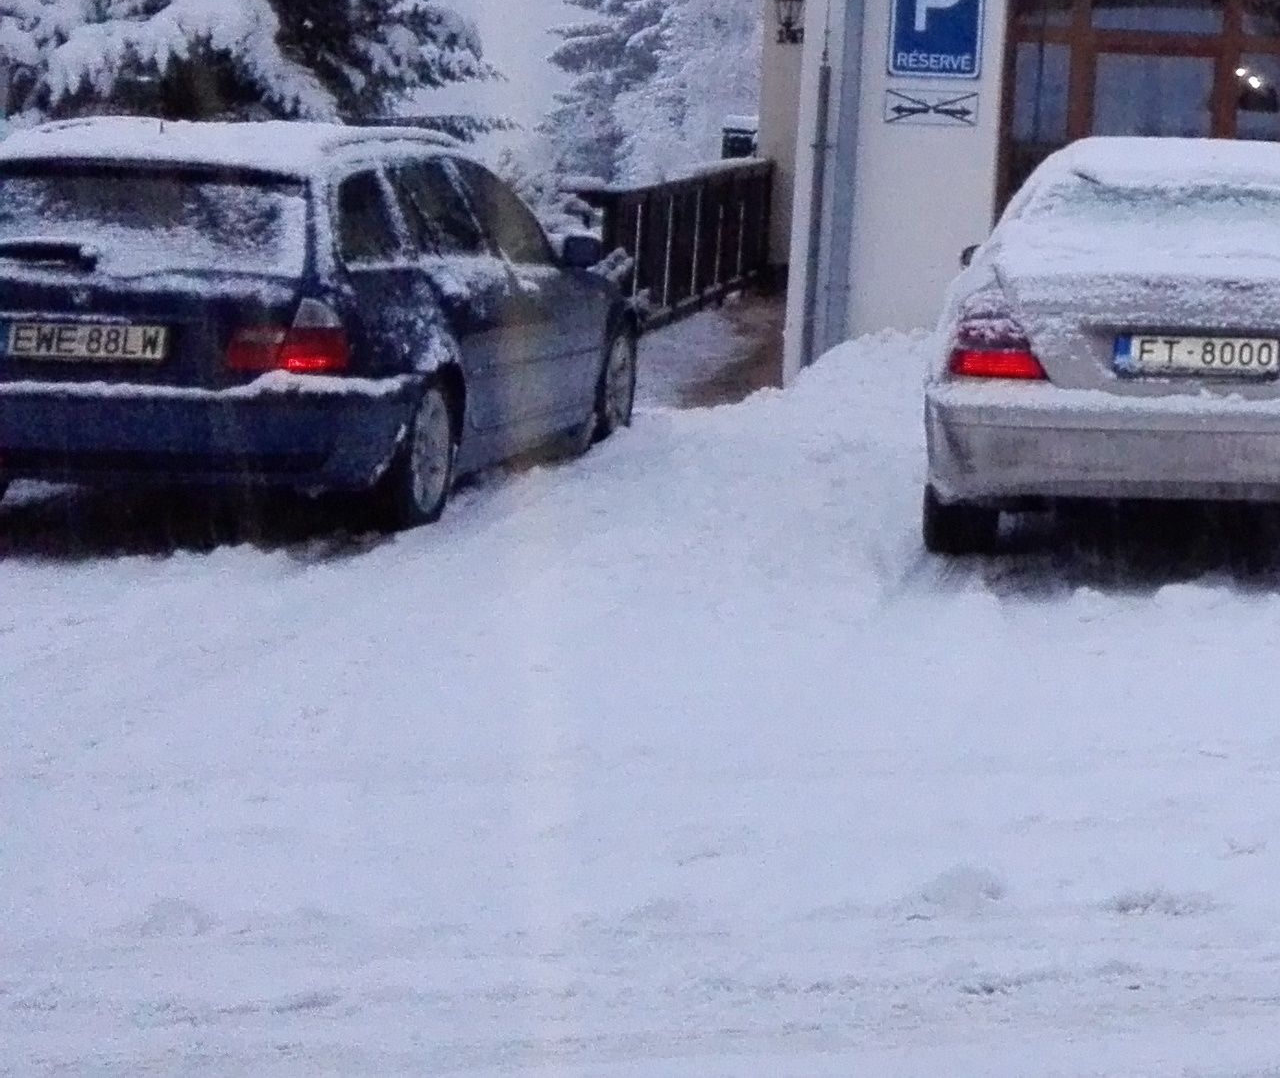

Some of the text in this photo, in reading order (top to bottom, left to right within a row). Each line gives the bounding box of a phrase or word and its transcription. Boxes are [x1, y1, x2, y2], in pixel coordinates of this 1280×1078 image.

[14, 323, 160, 355] EWE 88LW
[1140, 338, 1273, 366] FT-8000
